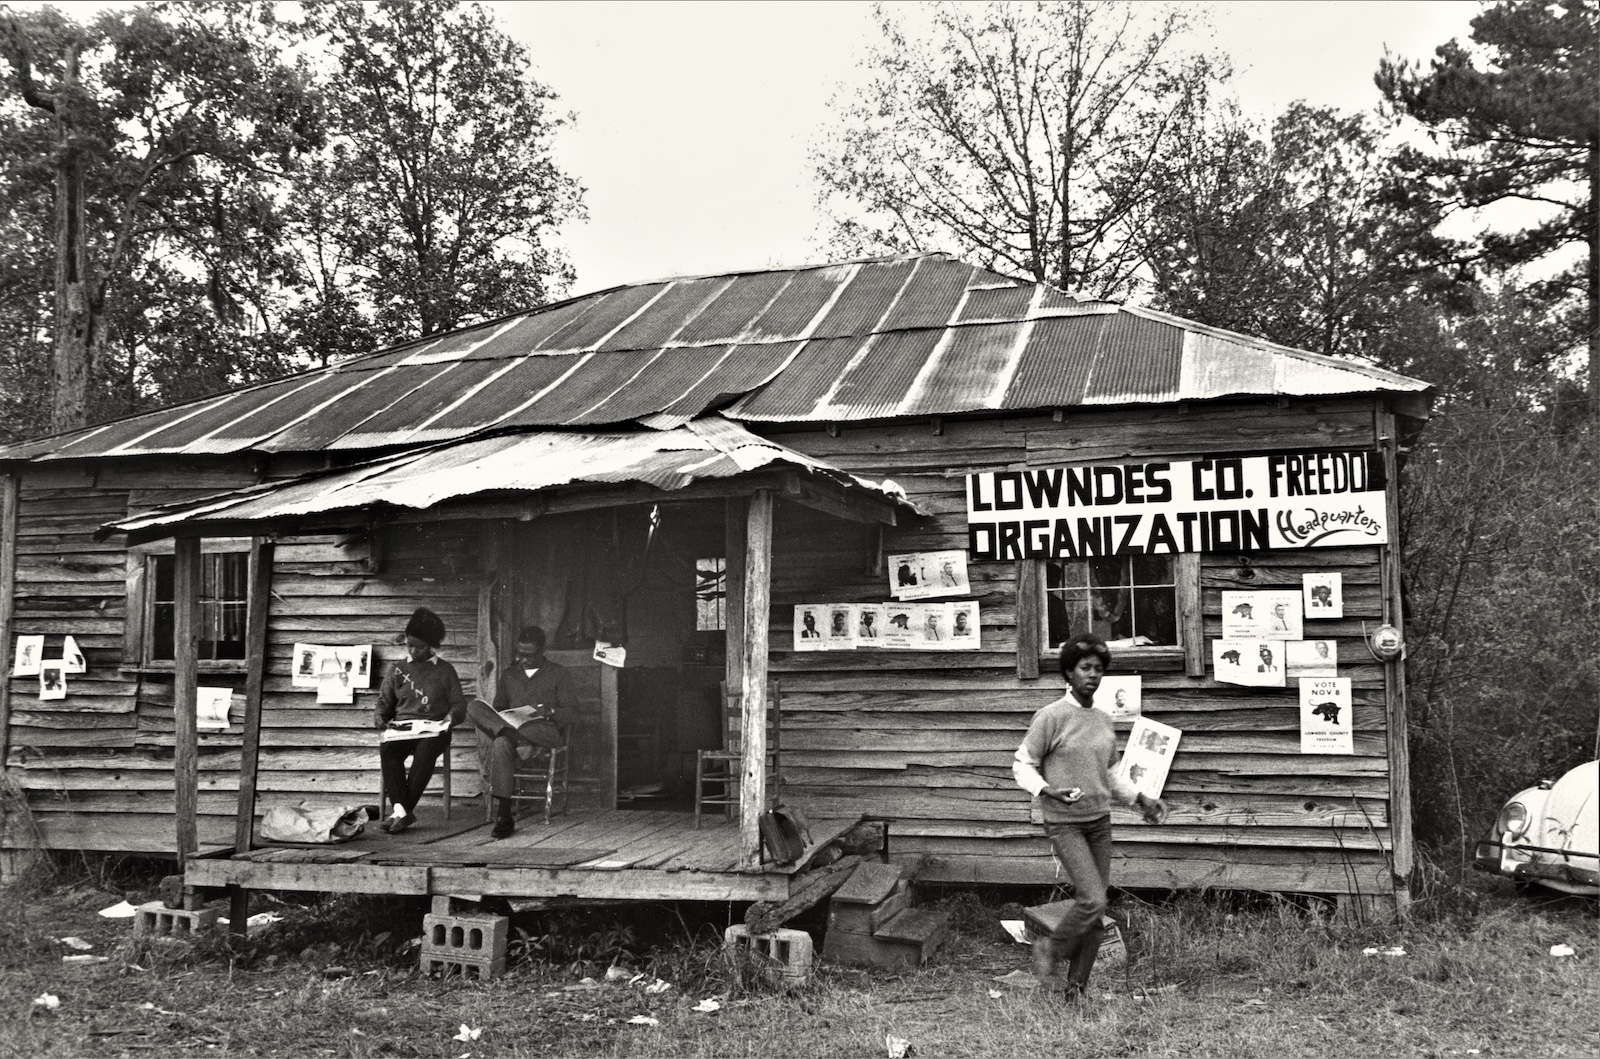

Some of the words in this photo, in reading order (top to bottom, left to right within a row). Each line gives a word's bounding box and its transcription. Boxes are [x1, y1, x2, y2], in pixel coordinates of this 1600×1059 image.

[972, 462, 1172, 511] LOWNDES
[1191, 458, 1253, 501] CO.
[1268, 451, 1386, 498] FREEDO
[968, 508, 1270, 560] ORGANIZATION
[1276, 505, 1381, 544] Headquarters
